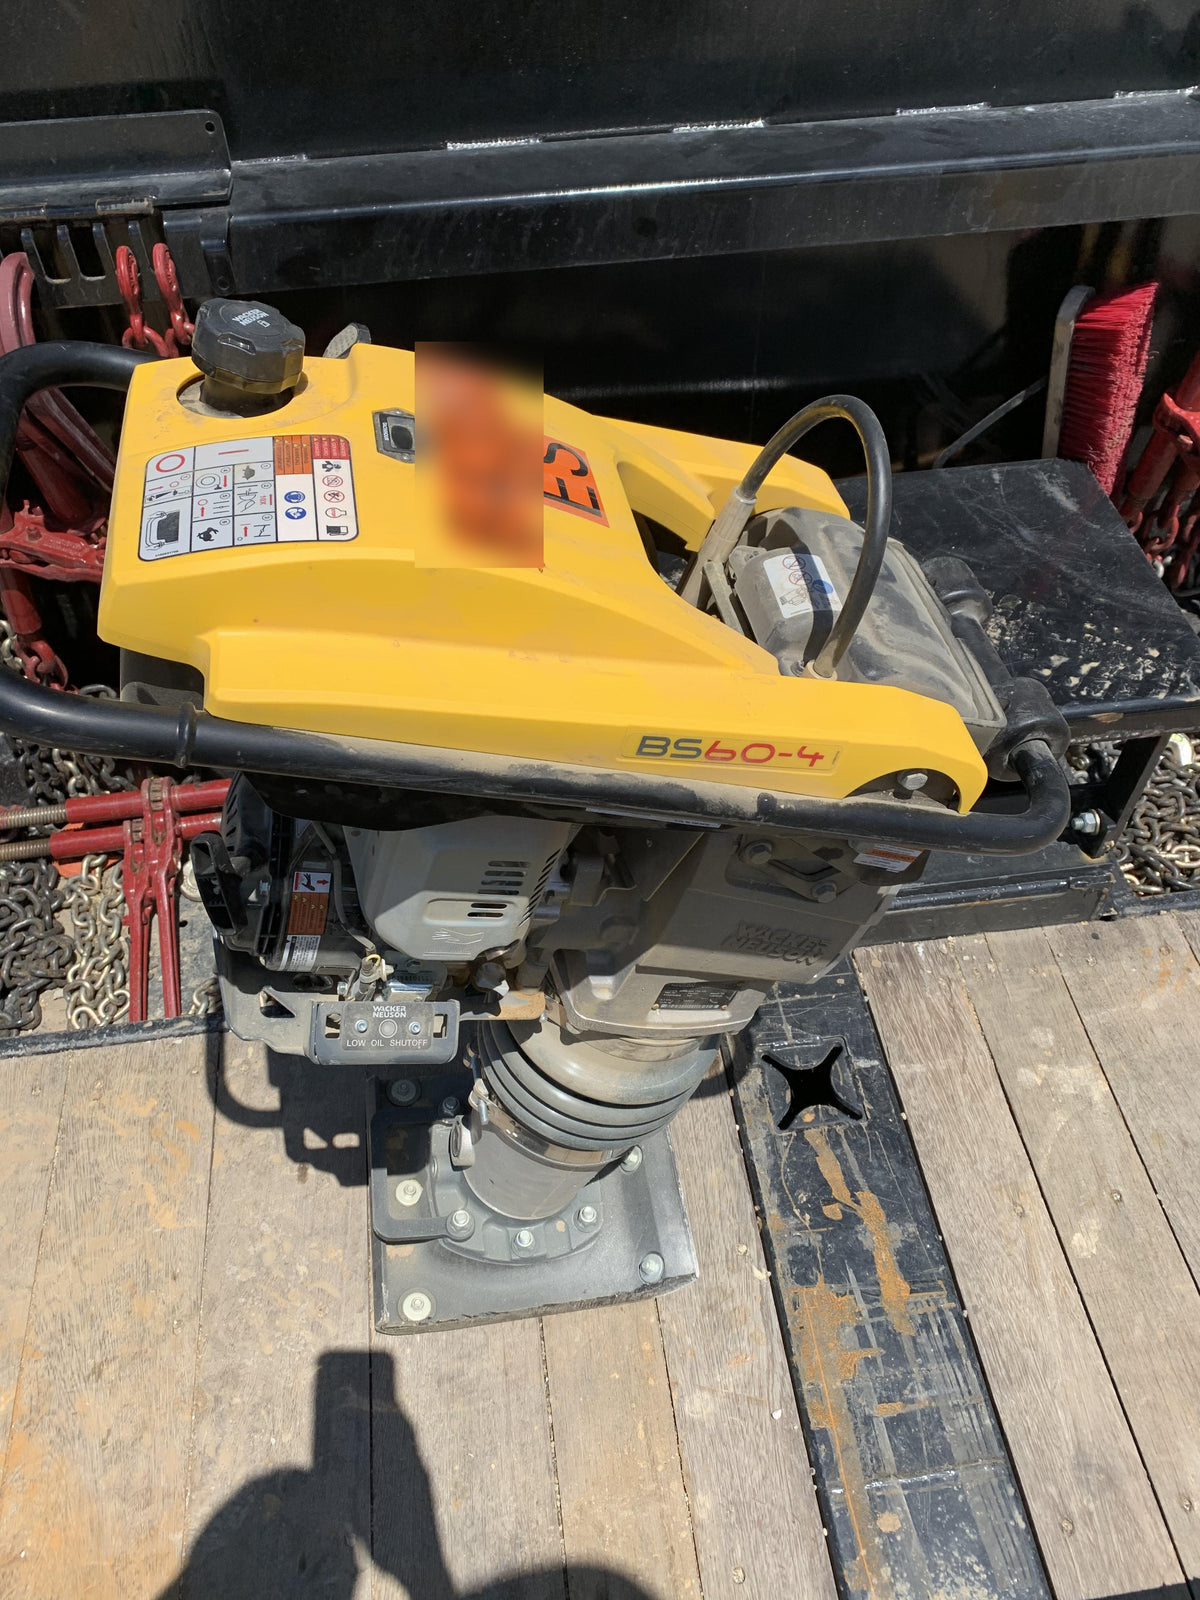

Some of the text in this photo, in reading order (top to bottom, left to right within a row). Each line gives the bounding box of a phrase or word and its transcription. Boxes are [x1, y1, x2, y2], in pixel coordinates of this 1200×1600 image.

[636, 735, 825, 767] BS60-4
[346, 1039, 428, 1047] LOW OIL SHUTOFF
